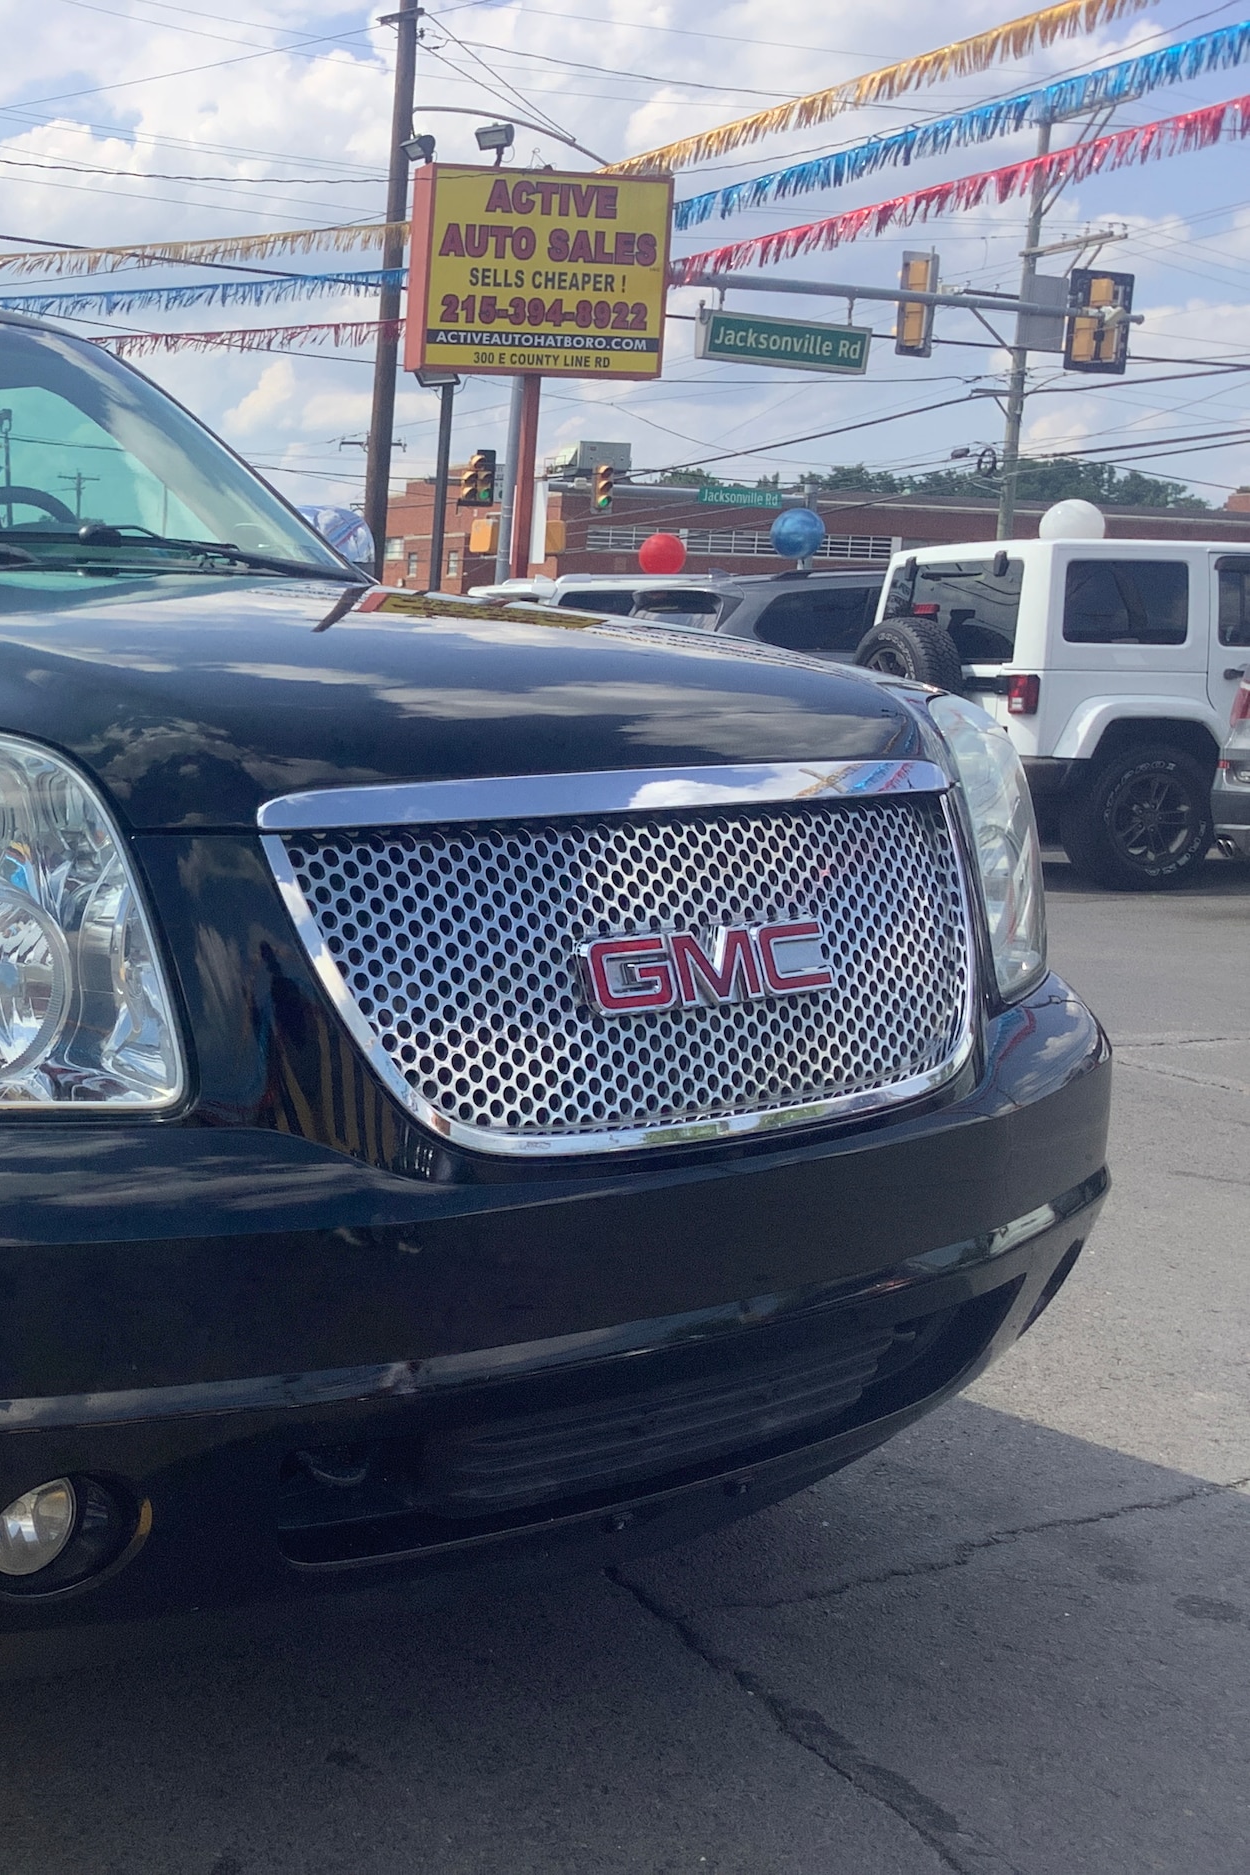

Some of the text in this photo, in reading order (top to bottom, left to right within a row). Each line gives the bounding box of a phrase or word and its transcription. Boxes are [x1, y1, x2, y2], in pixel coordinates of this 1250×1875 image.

[485, 179, 618, 219] ACTIVE
[438, 223, 657, 267] AUTO SALES
[469, 267, 525, 288] SELLS
[531, 270, 615, 292] CHEAPER
[439, 294, 648, 331] 215-394-8922
[436, 331, 647, 350] ACTIVEAUTOHATBORO.COM
[714, 326, 862, 359] Jacksonville Rd
[473, 352, 611, 368] 300 E COUNTY LINE RD
[702, 489, 779, 506] Jacksonville Rd
[586, 918, 835, 1013] GMC
